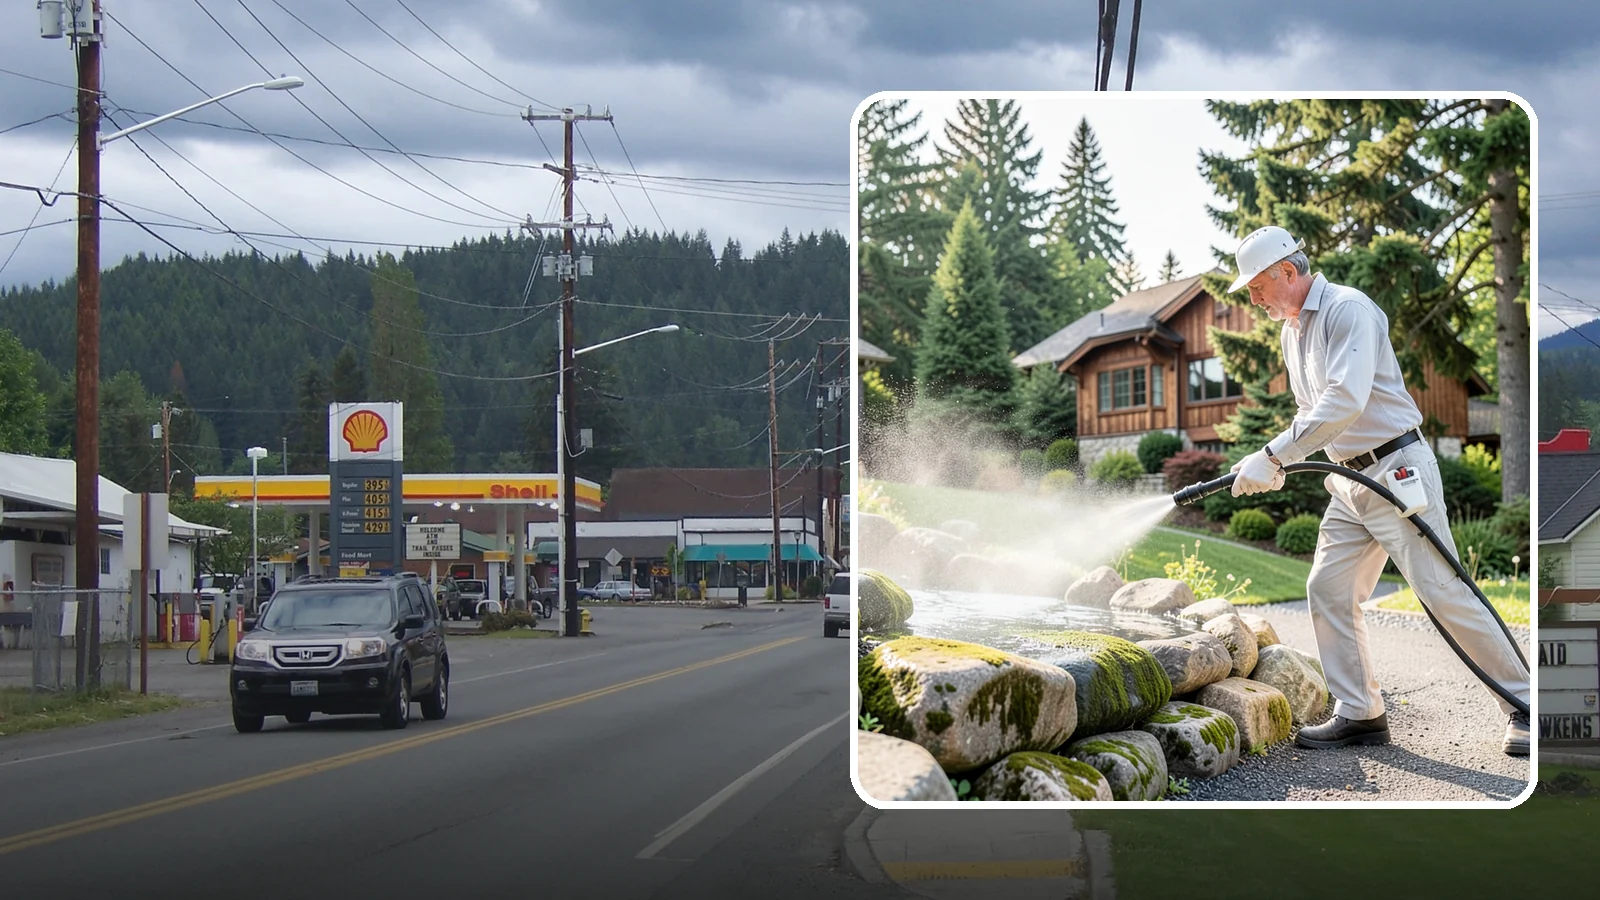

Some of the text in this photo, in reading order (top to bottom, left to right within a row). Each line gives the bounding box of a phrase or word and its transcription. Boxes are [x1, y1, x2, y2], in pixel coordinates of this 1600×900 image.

[366, 480, 383, 490] 395
[490, 484, 547, 499] Shell
[366, 494, 383, 504] 405
[366, 508, 383, 518] 415
[366, 522, 383, 532] 429
